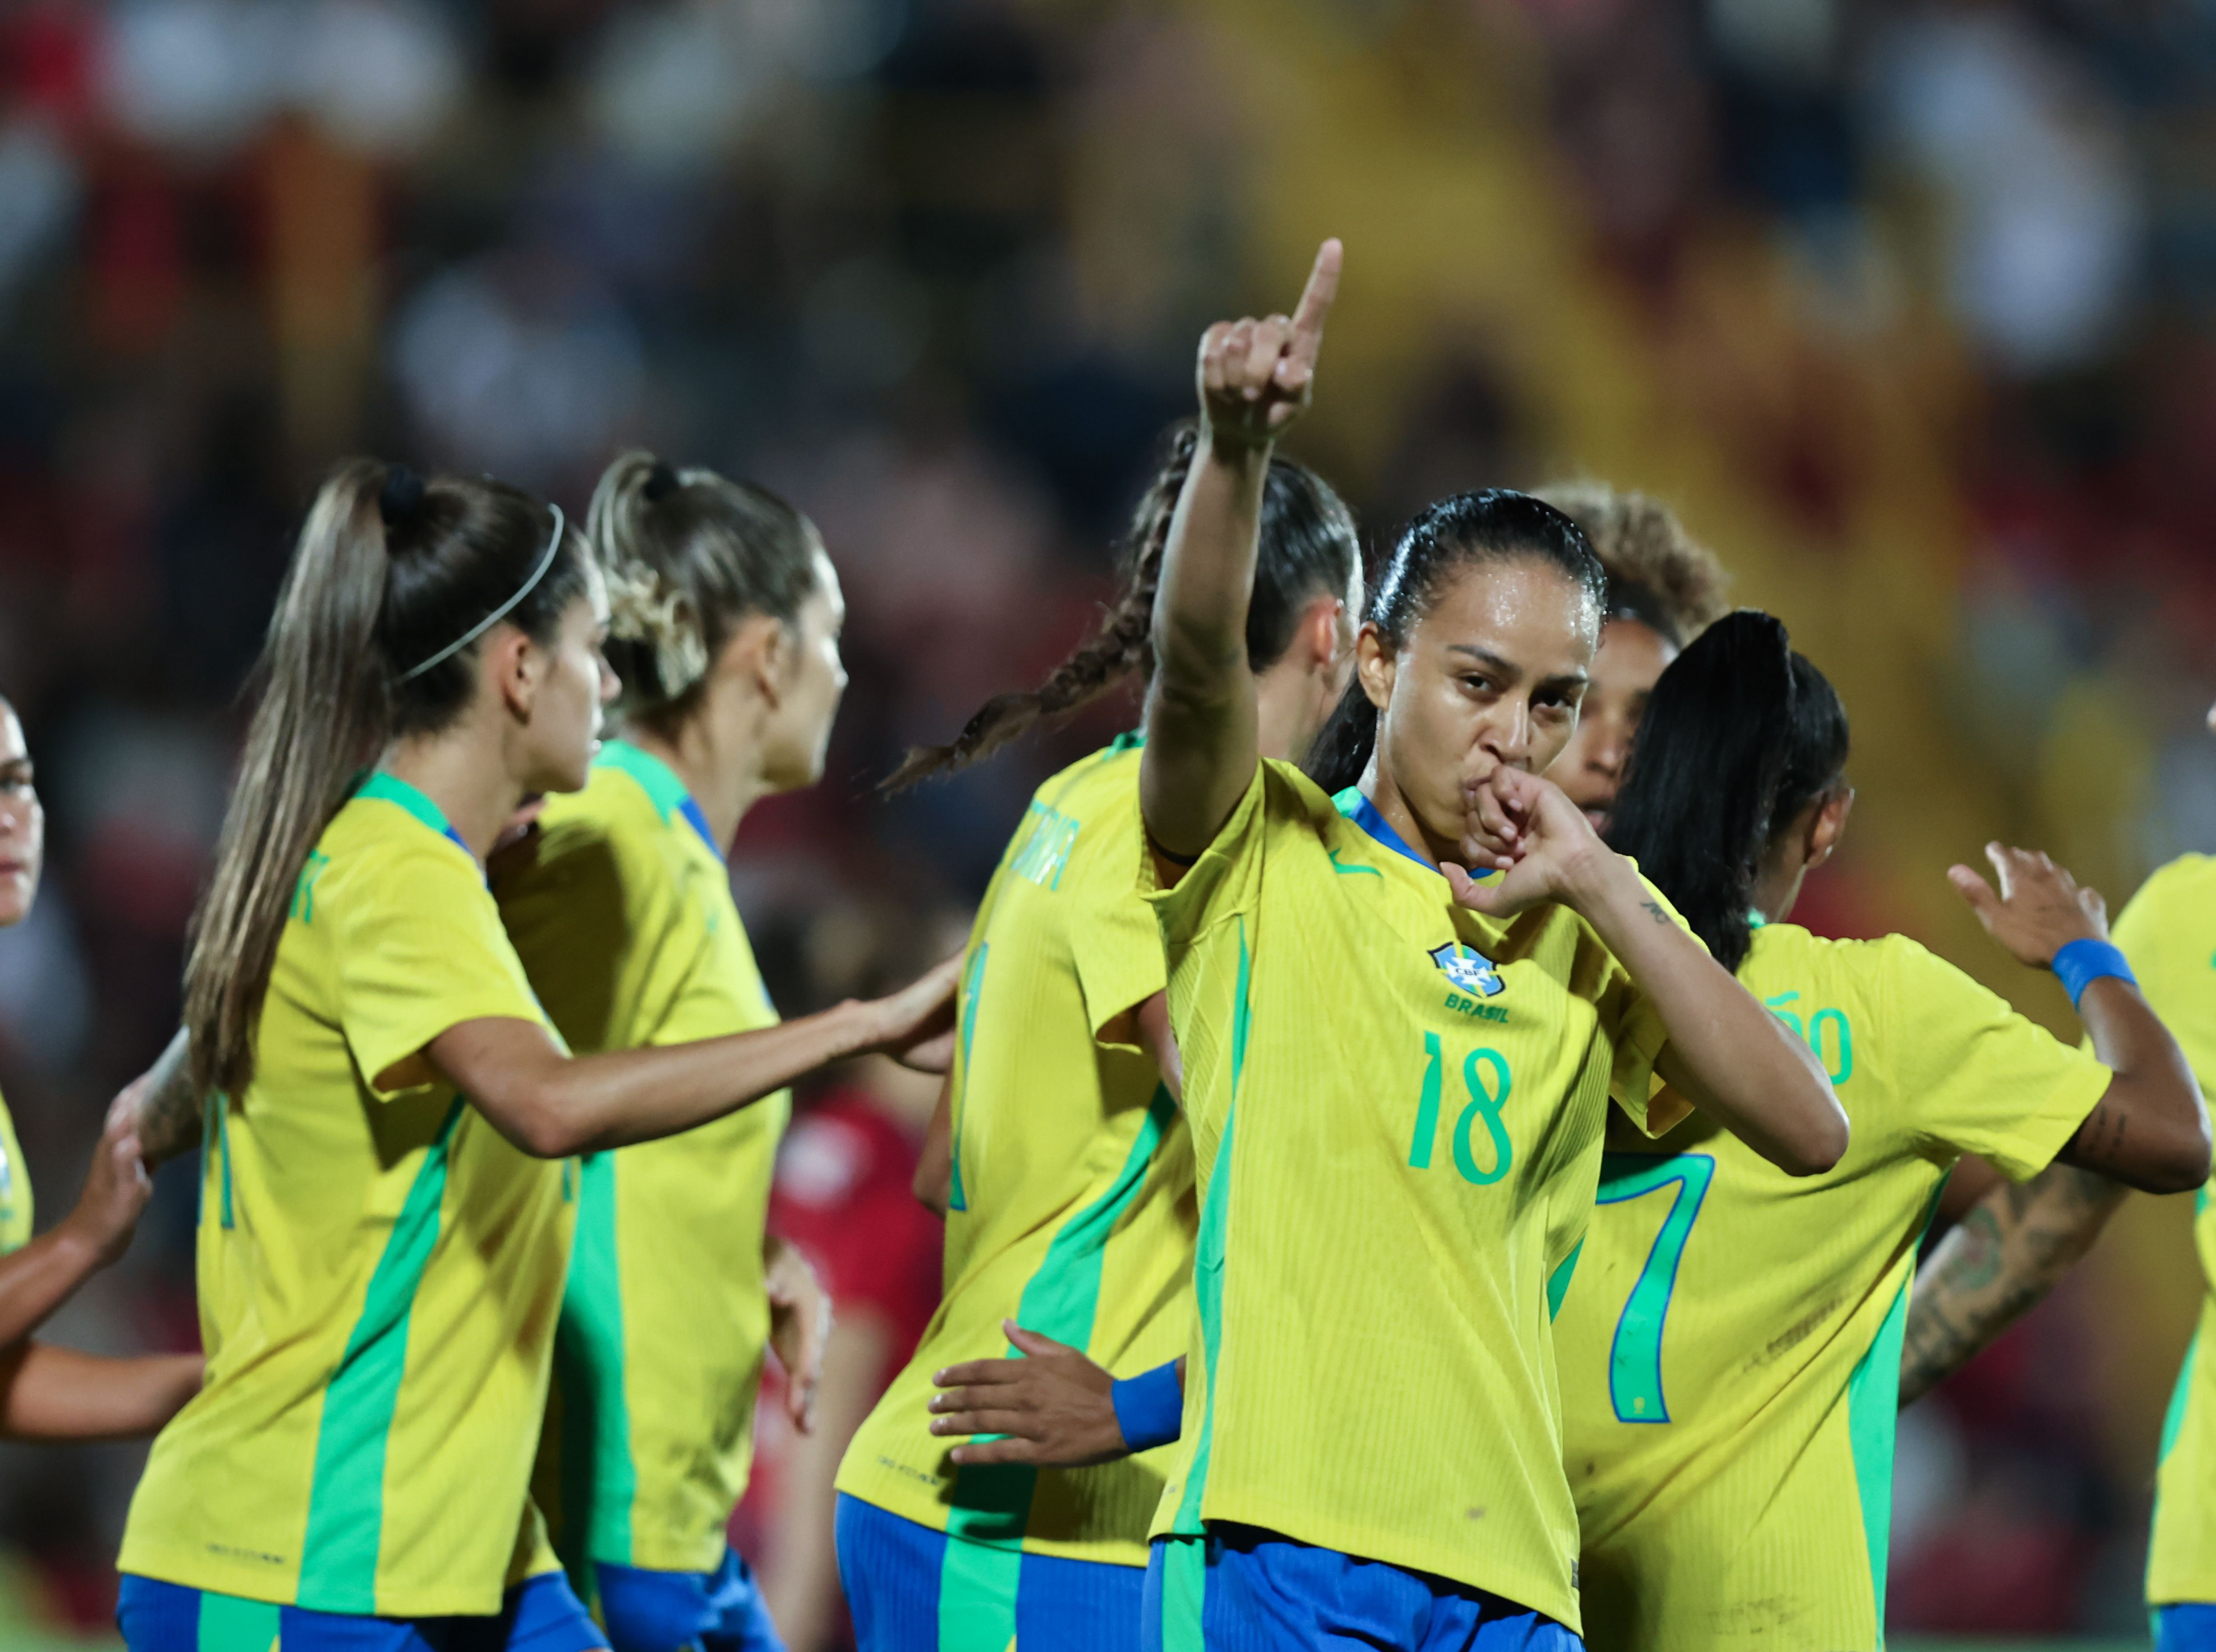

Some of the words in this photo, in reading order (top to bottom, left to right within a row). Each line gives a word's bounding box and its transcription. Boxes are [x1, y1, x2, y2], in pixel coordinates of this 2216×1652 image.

[1444, 992, 1509, 1023] BRASIL
[1455, 967, 1480, 976] CBF
[1408, 1030, 1512, 1186] 18
[1595, 1153, 1715, 1423] 7
